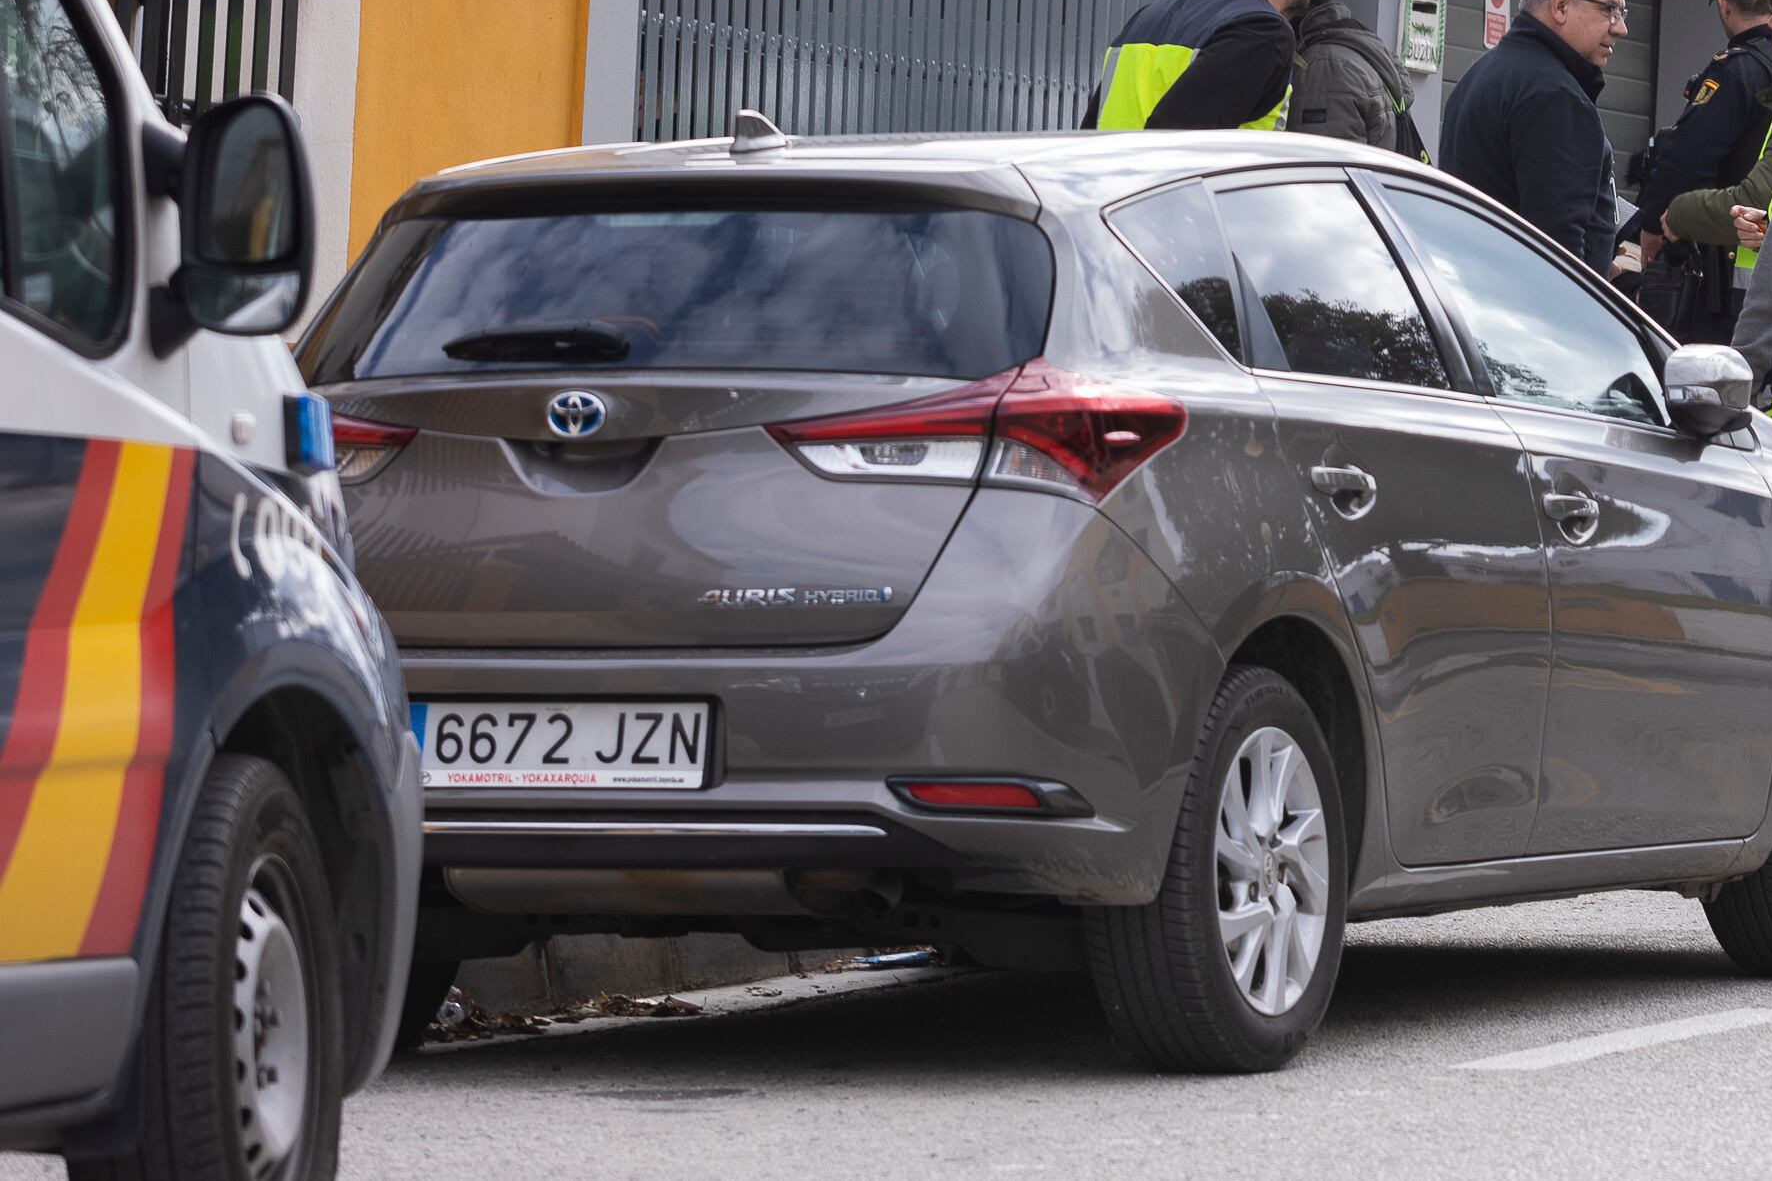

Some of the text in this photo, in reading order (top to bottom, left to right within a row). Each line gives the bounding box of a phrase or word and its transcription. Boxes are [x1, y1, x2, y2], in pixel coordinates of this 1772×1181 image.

[698, 587, 796, 606] AURIS
[435, 712, 702, 765] 6672 JZN
[447, 772, 514, 784] YOKAMOTRIL
[521, 772, 597, 785] YOKAXARQUIA
